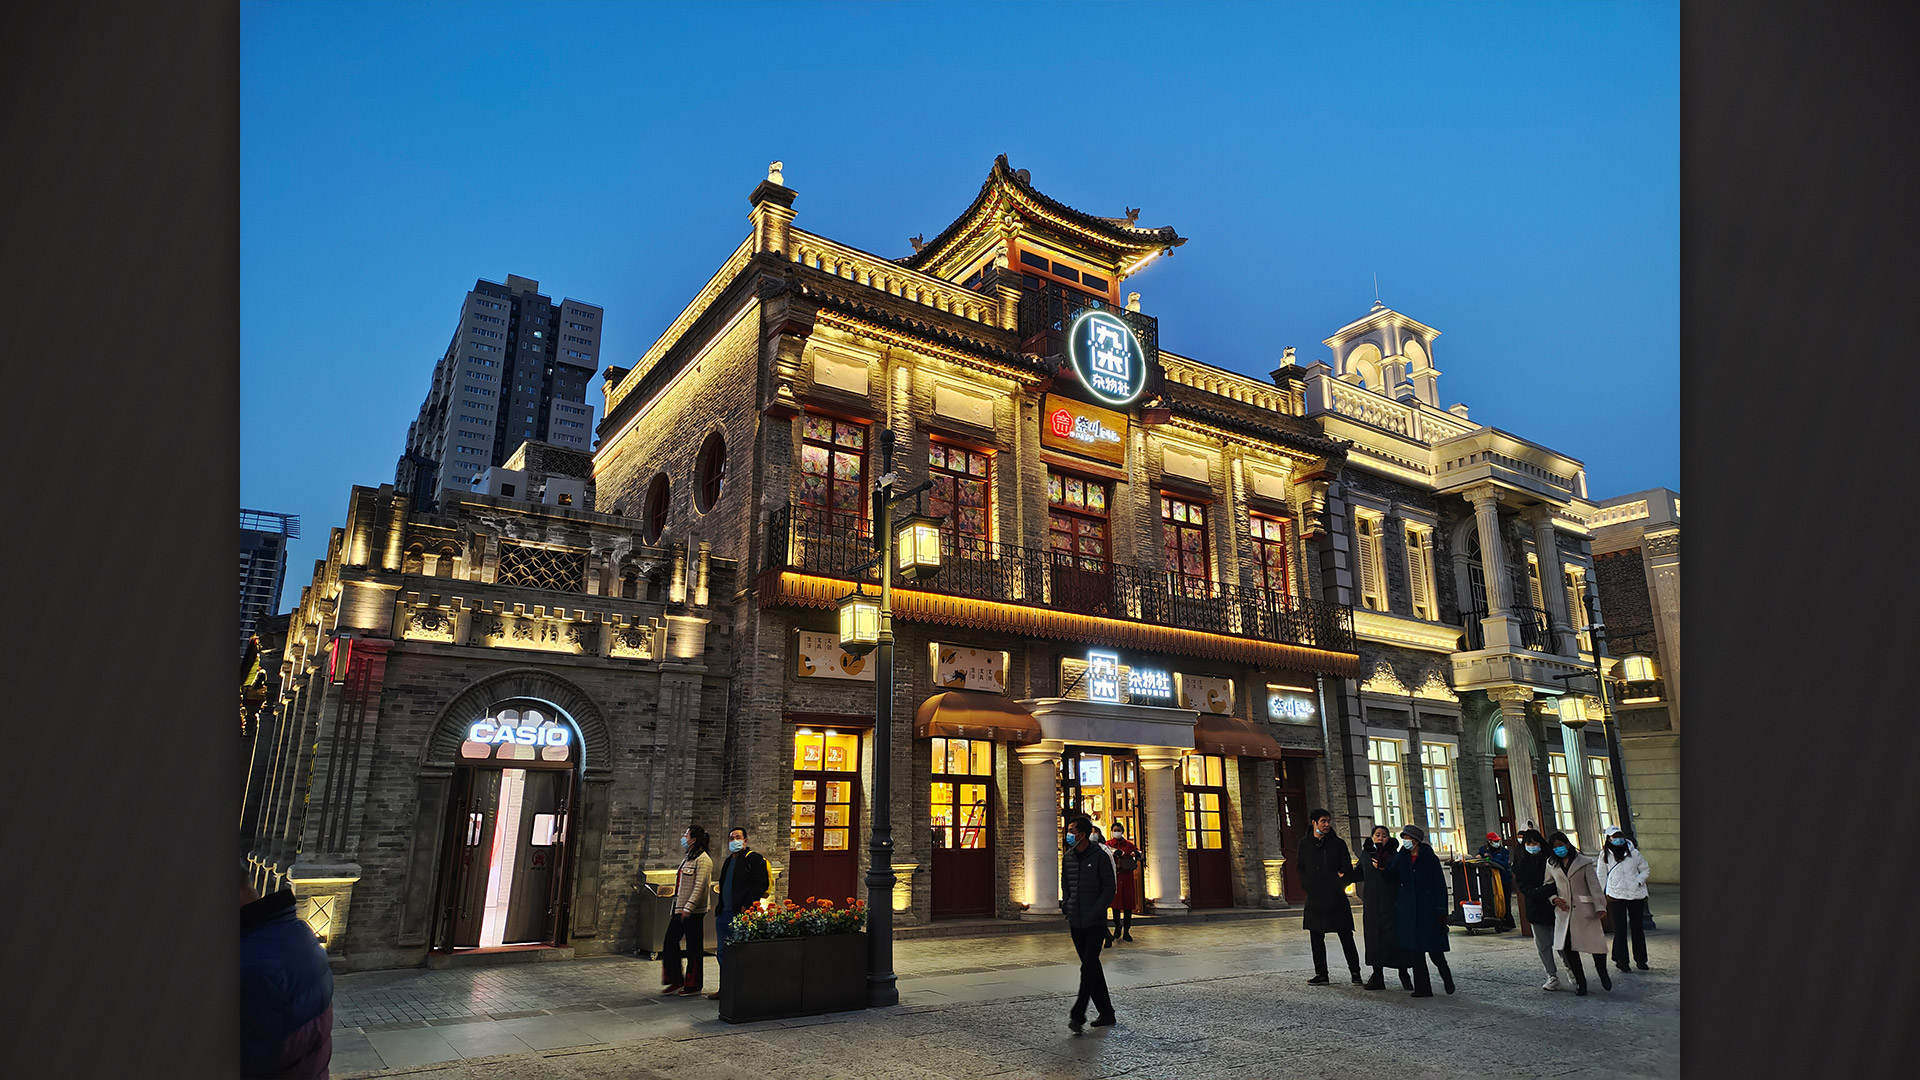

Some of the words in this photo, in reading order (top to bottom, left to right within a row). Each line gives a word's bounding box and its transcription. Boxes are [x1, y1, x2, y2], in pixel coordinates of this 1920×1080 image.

[1092, 373, 1131, 396] 杂物社
[1128, 669, 1170, 691] 杂物社
[470, 723, 569, 746] CASIO
